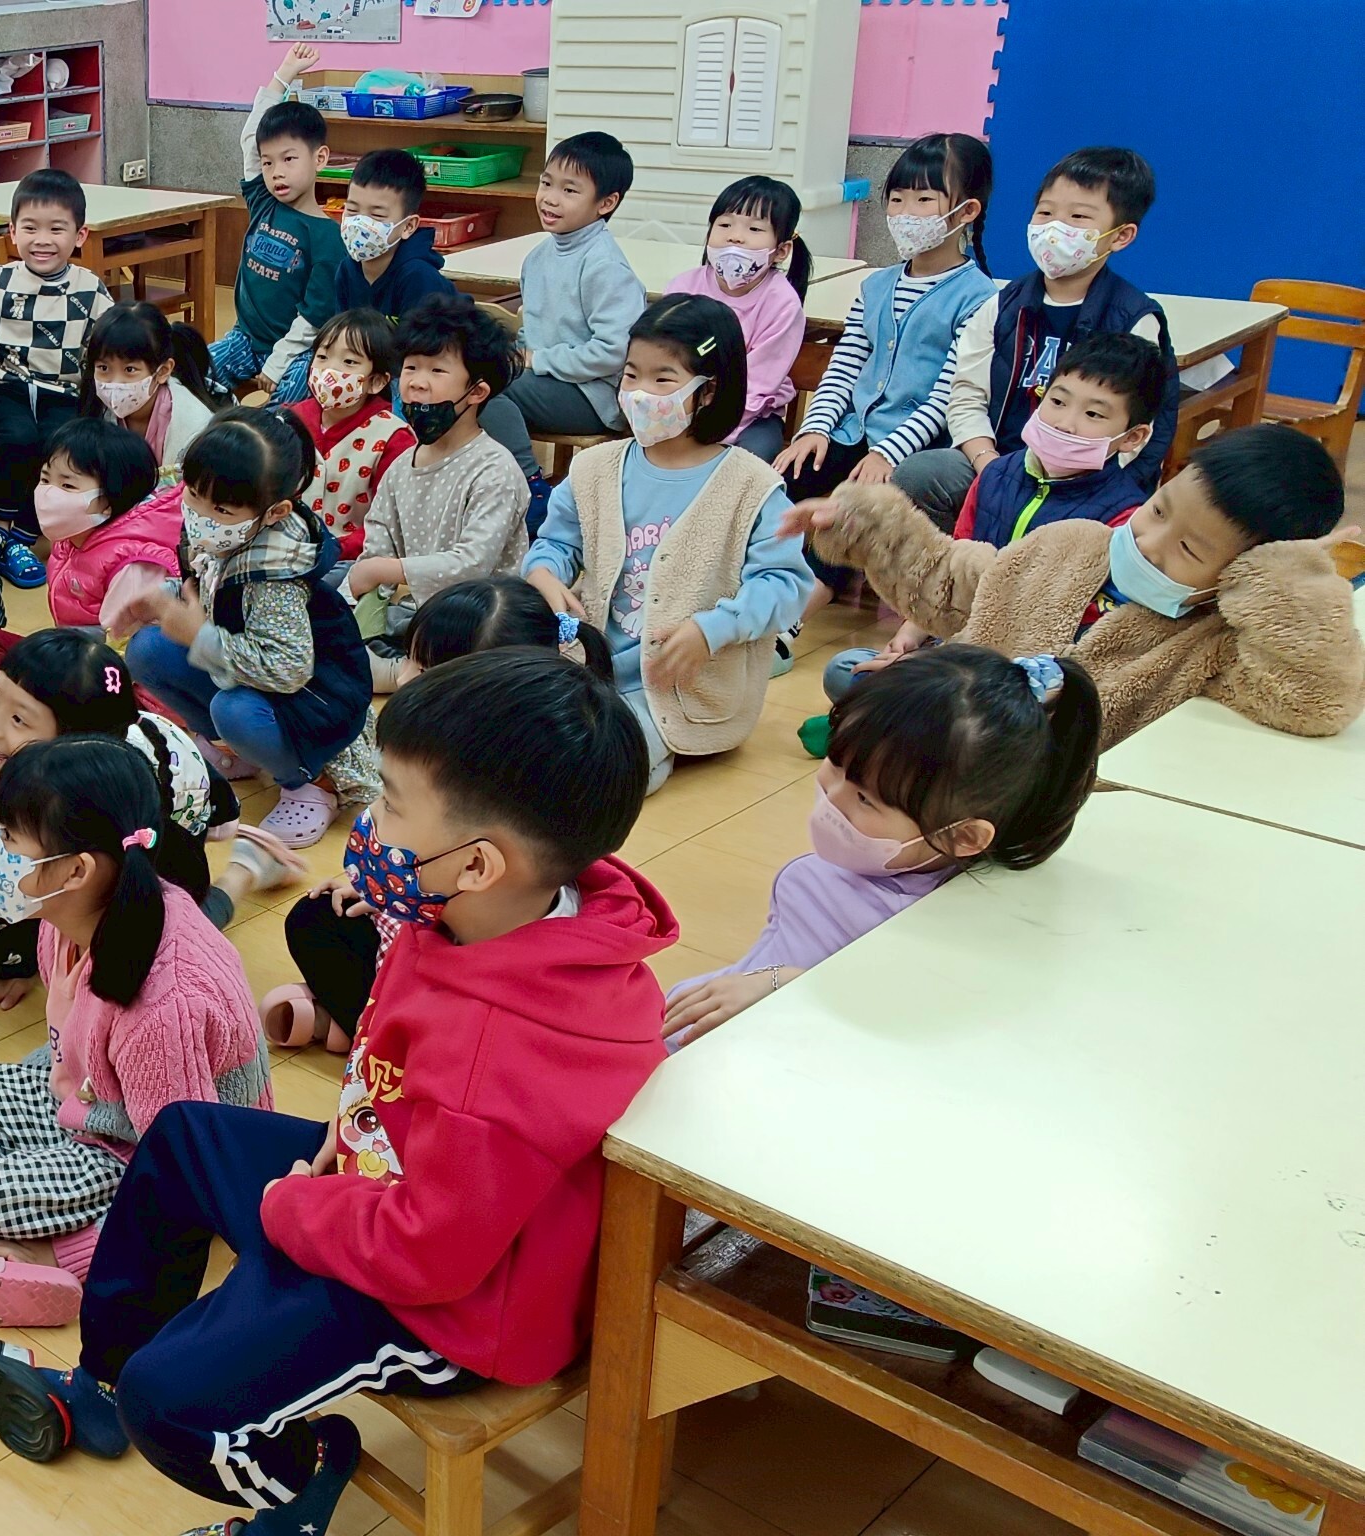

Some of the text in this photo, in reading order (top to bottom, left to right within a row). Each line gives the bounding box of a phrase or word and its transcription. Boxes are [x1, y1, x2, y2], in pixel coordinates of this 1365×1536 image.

[253, 235, 288, 257] Gonna
[260, 222, 299, 246] SKATERS
[246, 258, 281, 282] SKATE
